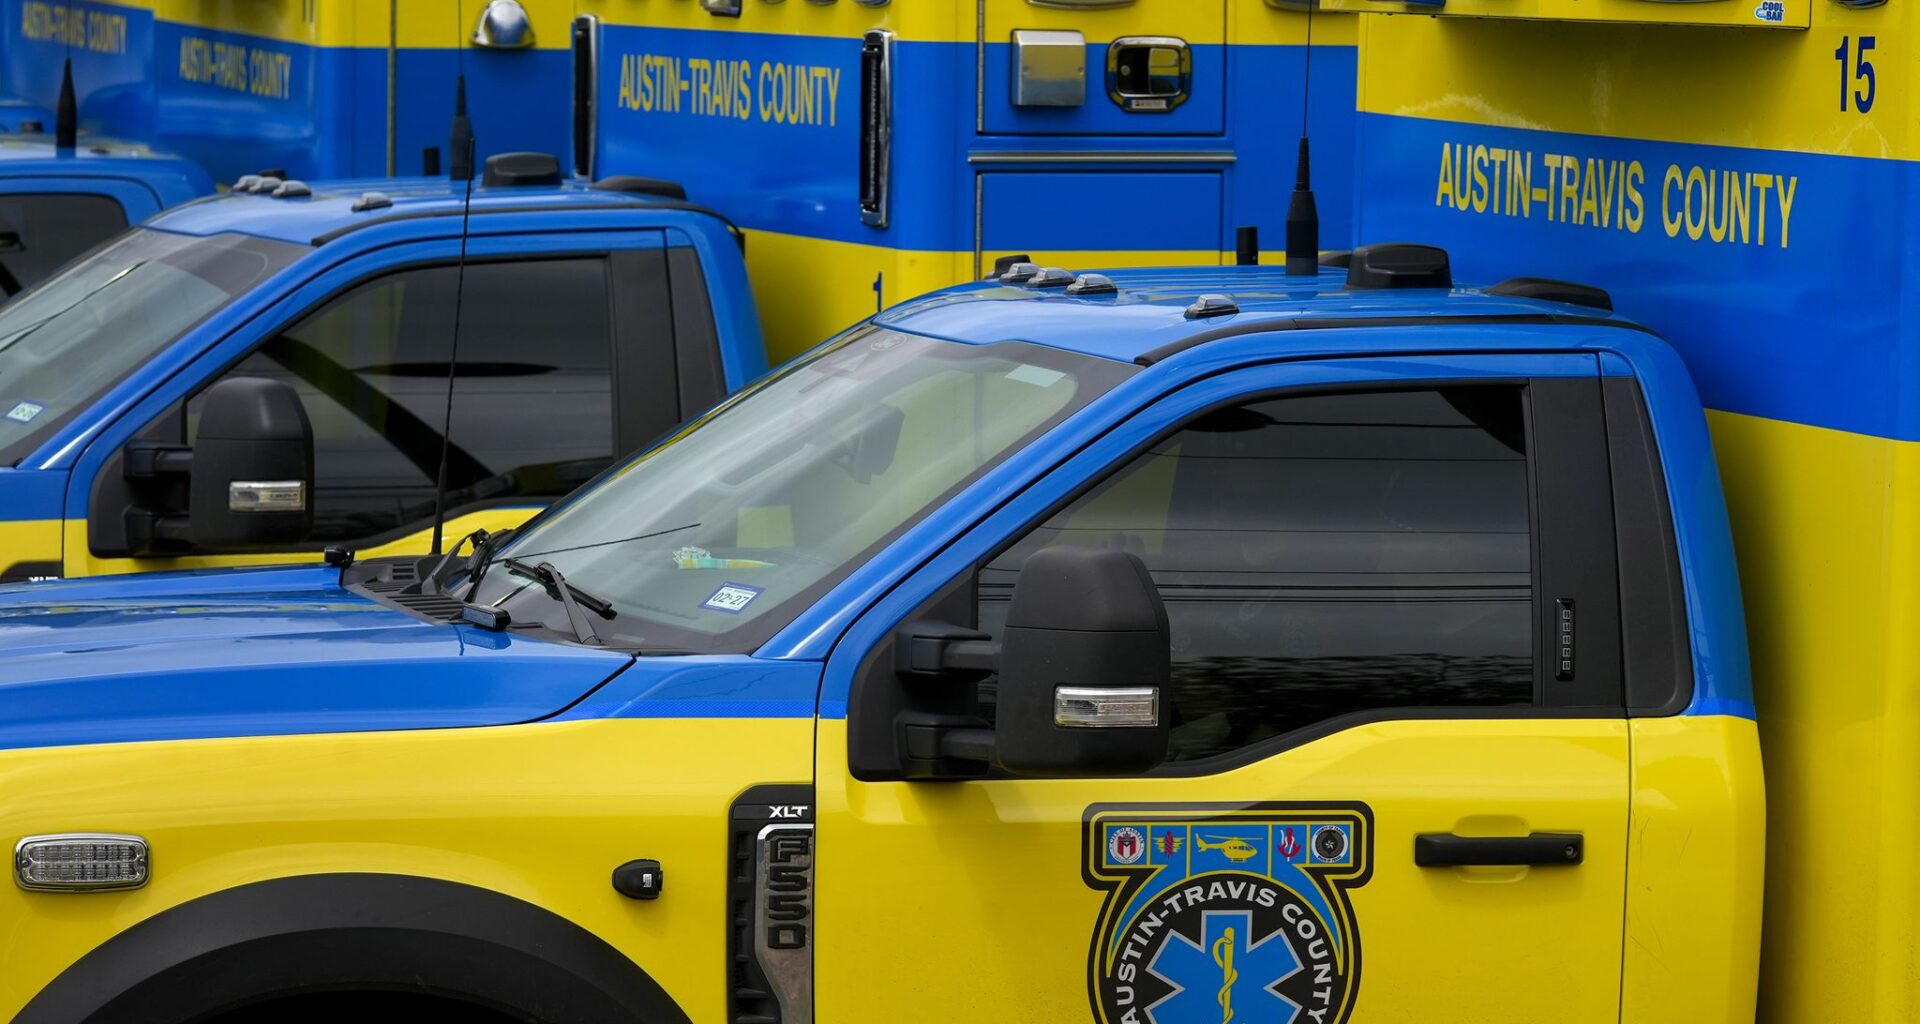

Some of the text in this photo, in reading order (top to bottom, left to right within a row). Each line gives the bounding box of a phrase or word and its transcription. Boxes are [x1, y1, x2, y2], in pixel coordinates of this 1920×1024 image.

[87, 12, 126, 55] COUNTY
[1762, 2, 1784, 12] COOL
[1766, 11, 1783, 22] BAR
[179, 36, 291, 100] AUSTIN-TRAVIS COUNTY
[618, 53, 840, 127] AUSTIN-TRAVIS COUNTY
[1835, 36, 1876, 113] 15
[1436, 142, 1798, 249] AUSTIN-TRAVIS COUNTY
[769, 806, 808, 818] XLT
[767, 835, 810, 950] F550
[1116, 881, 1332, 1024] AUSTIN-TRAVIS COUNTY
